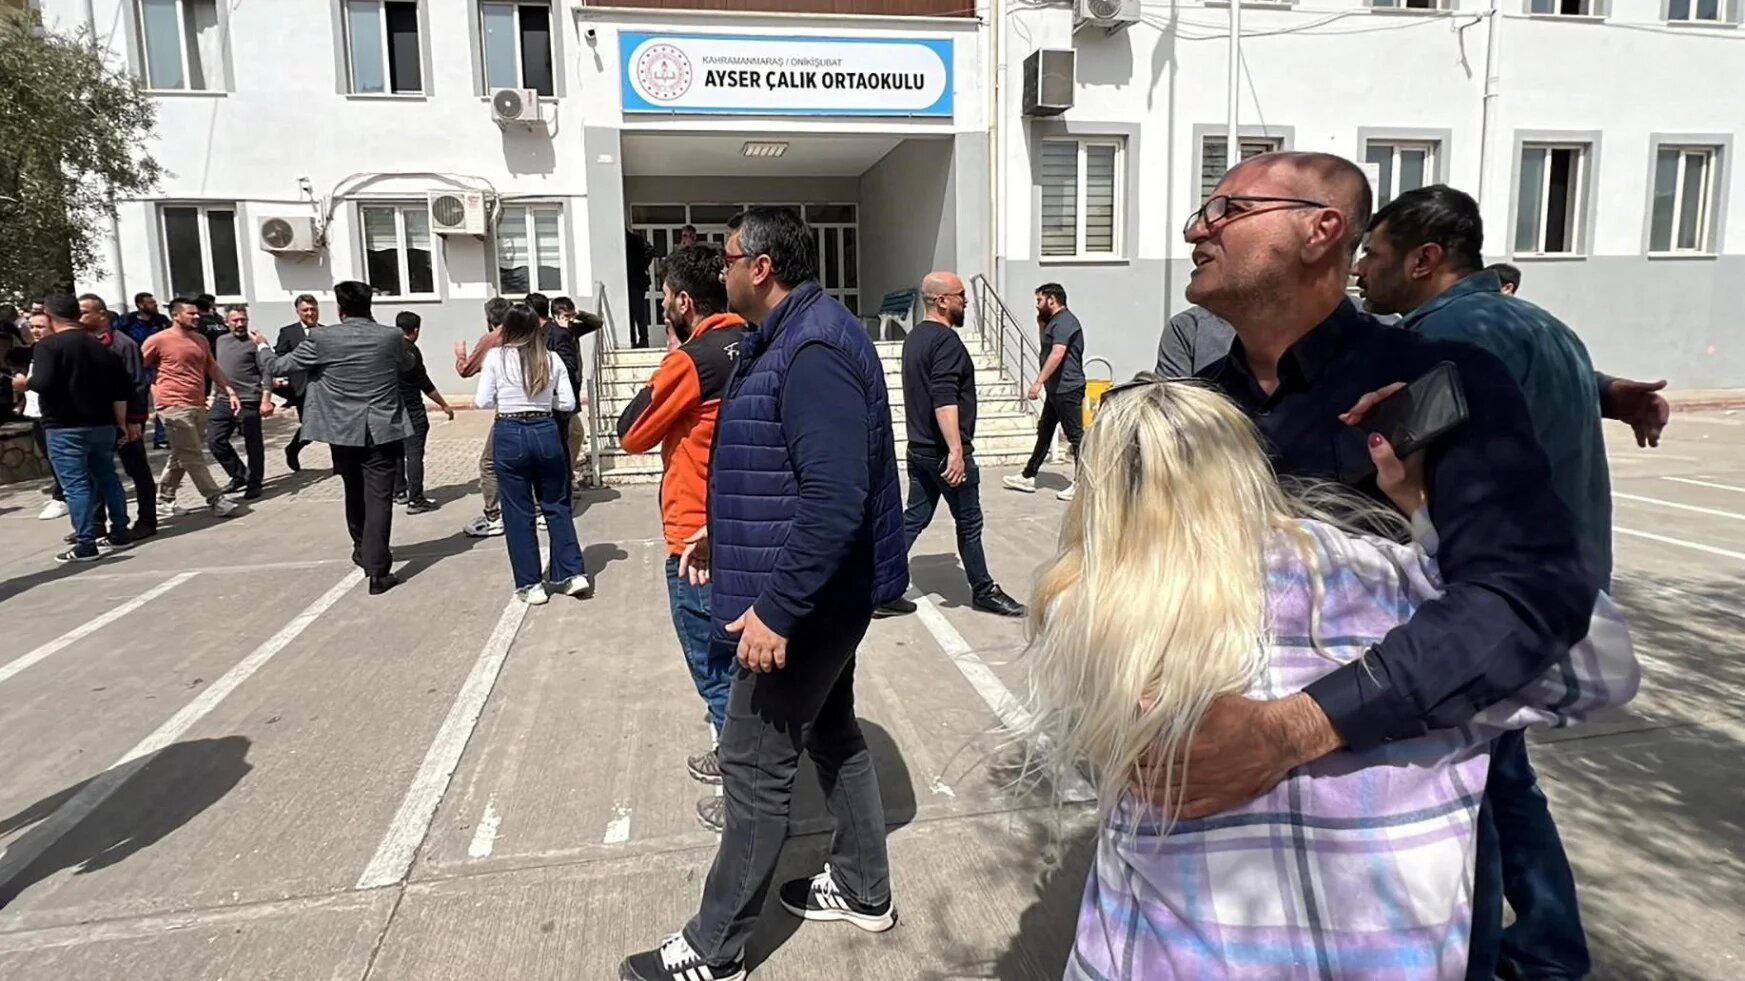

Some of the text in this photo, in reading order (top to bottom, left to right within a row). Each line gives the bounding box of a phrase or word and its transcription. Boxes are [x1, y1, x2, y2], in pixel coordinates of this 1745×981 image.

[702, 56, 784, 67] KAHRAMANMARAŞ
[704, 70, 761, 88] AYSER
[765, 71, 817, 91] ÇALIK
[821, 72, 925, 90] ORTAOKULU
